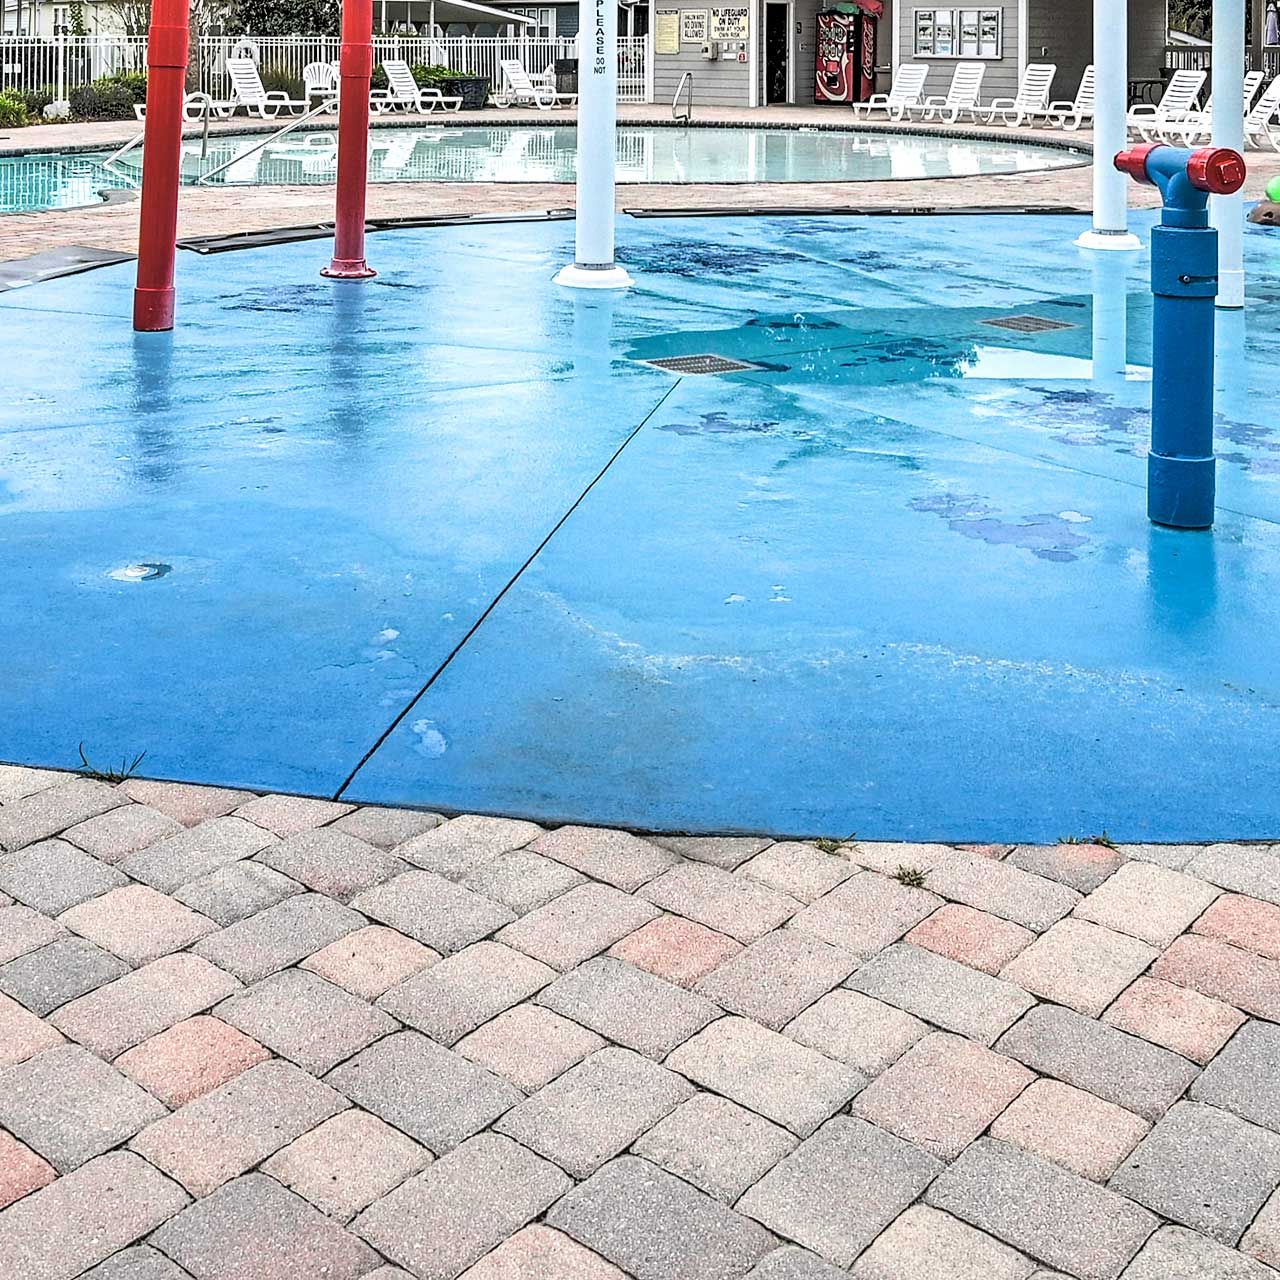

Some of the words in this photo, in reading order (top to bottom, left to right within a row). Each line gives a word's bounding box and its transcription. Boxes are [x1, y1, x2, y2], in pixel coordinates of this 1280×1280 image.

[712, 8, 719, 17] NO
[721, 8, 748, 17] LIFEGUARD
[719, 17, 726, 26] ON
[728, 17, 740, 26] DUTY
[595, 0, 605, 55] PLEASE
[684, 29, 704, 38] ALLOWED
[596, 57, 605, 65] DO
[594, 66, 606, 75] NOT
